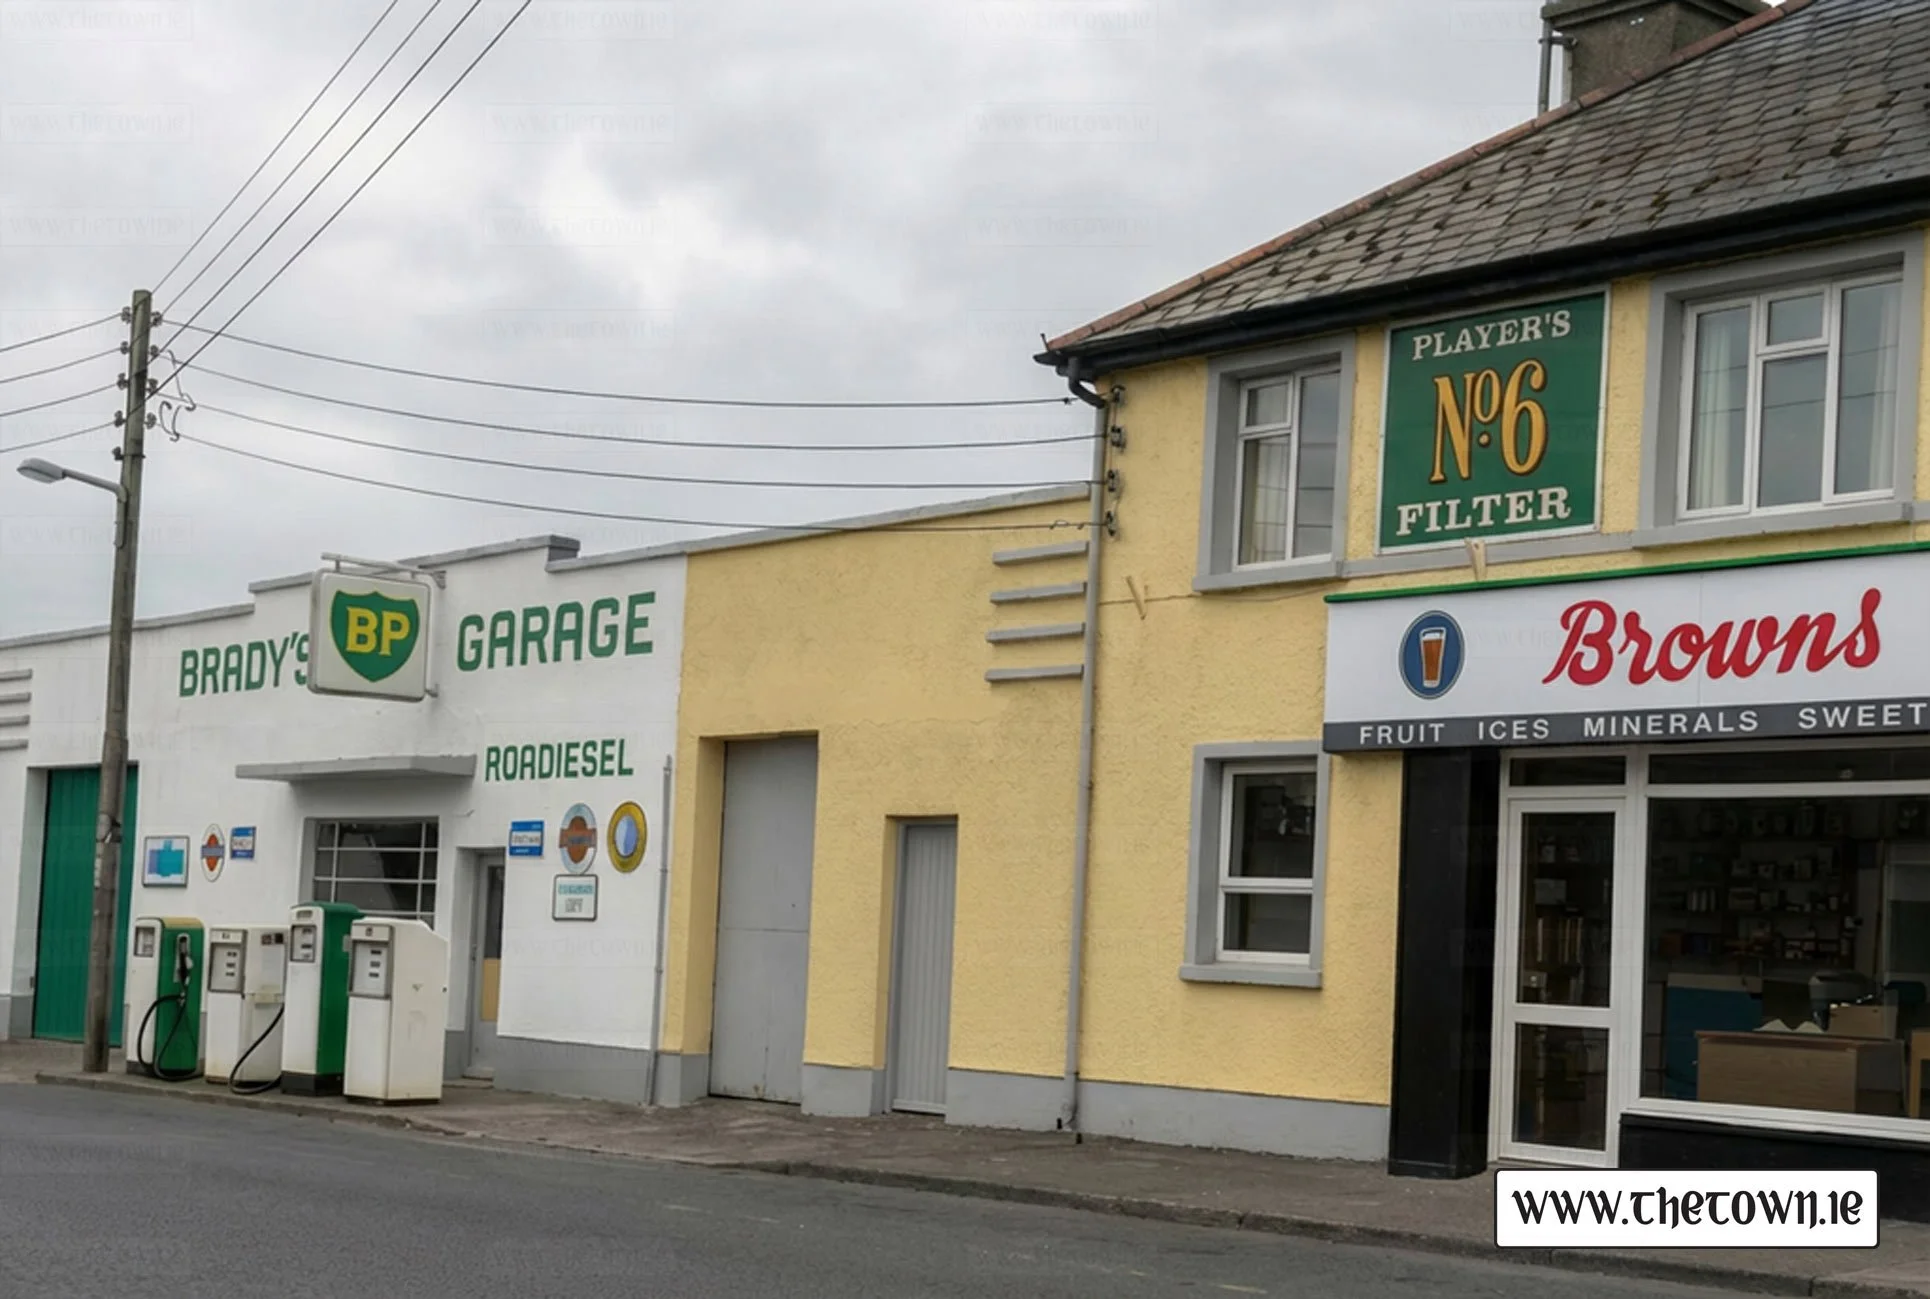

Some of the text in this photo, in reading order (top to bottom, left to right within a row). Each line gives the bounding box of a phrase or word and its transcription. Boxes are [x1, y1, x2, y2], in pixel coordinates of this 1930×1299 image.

[1412, 310, 1571, 361] PLAYER'S
[1396, 486, 1571, 536] FILTER
[346, 606, 411, 656] BP
[456, 591, 656, 672] GARAGE
[1542, 588, 1881, 686] Browns
[1360, 703, 1928, 745] FRUIT ICES MINERALS SWEET
[485, 738, 634, 782] ROADIESEL
